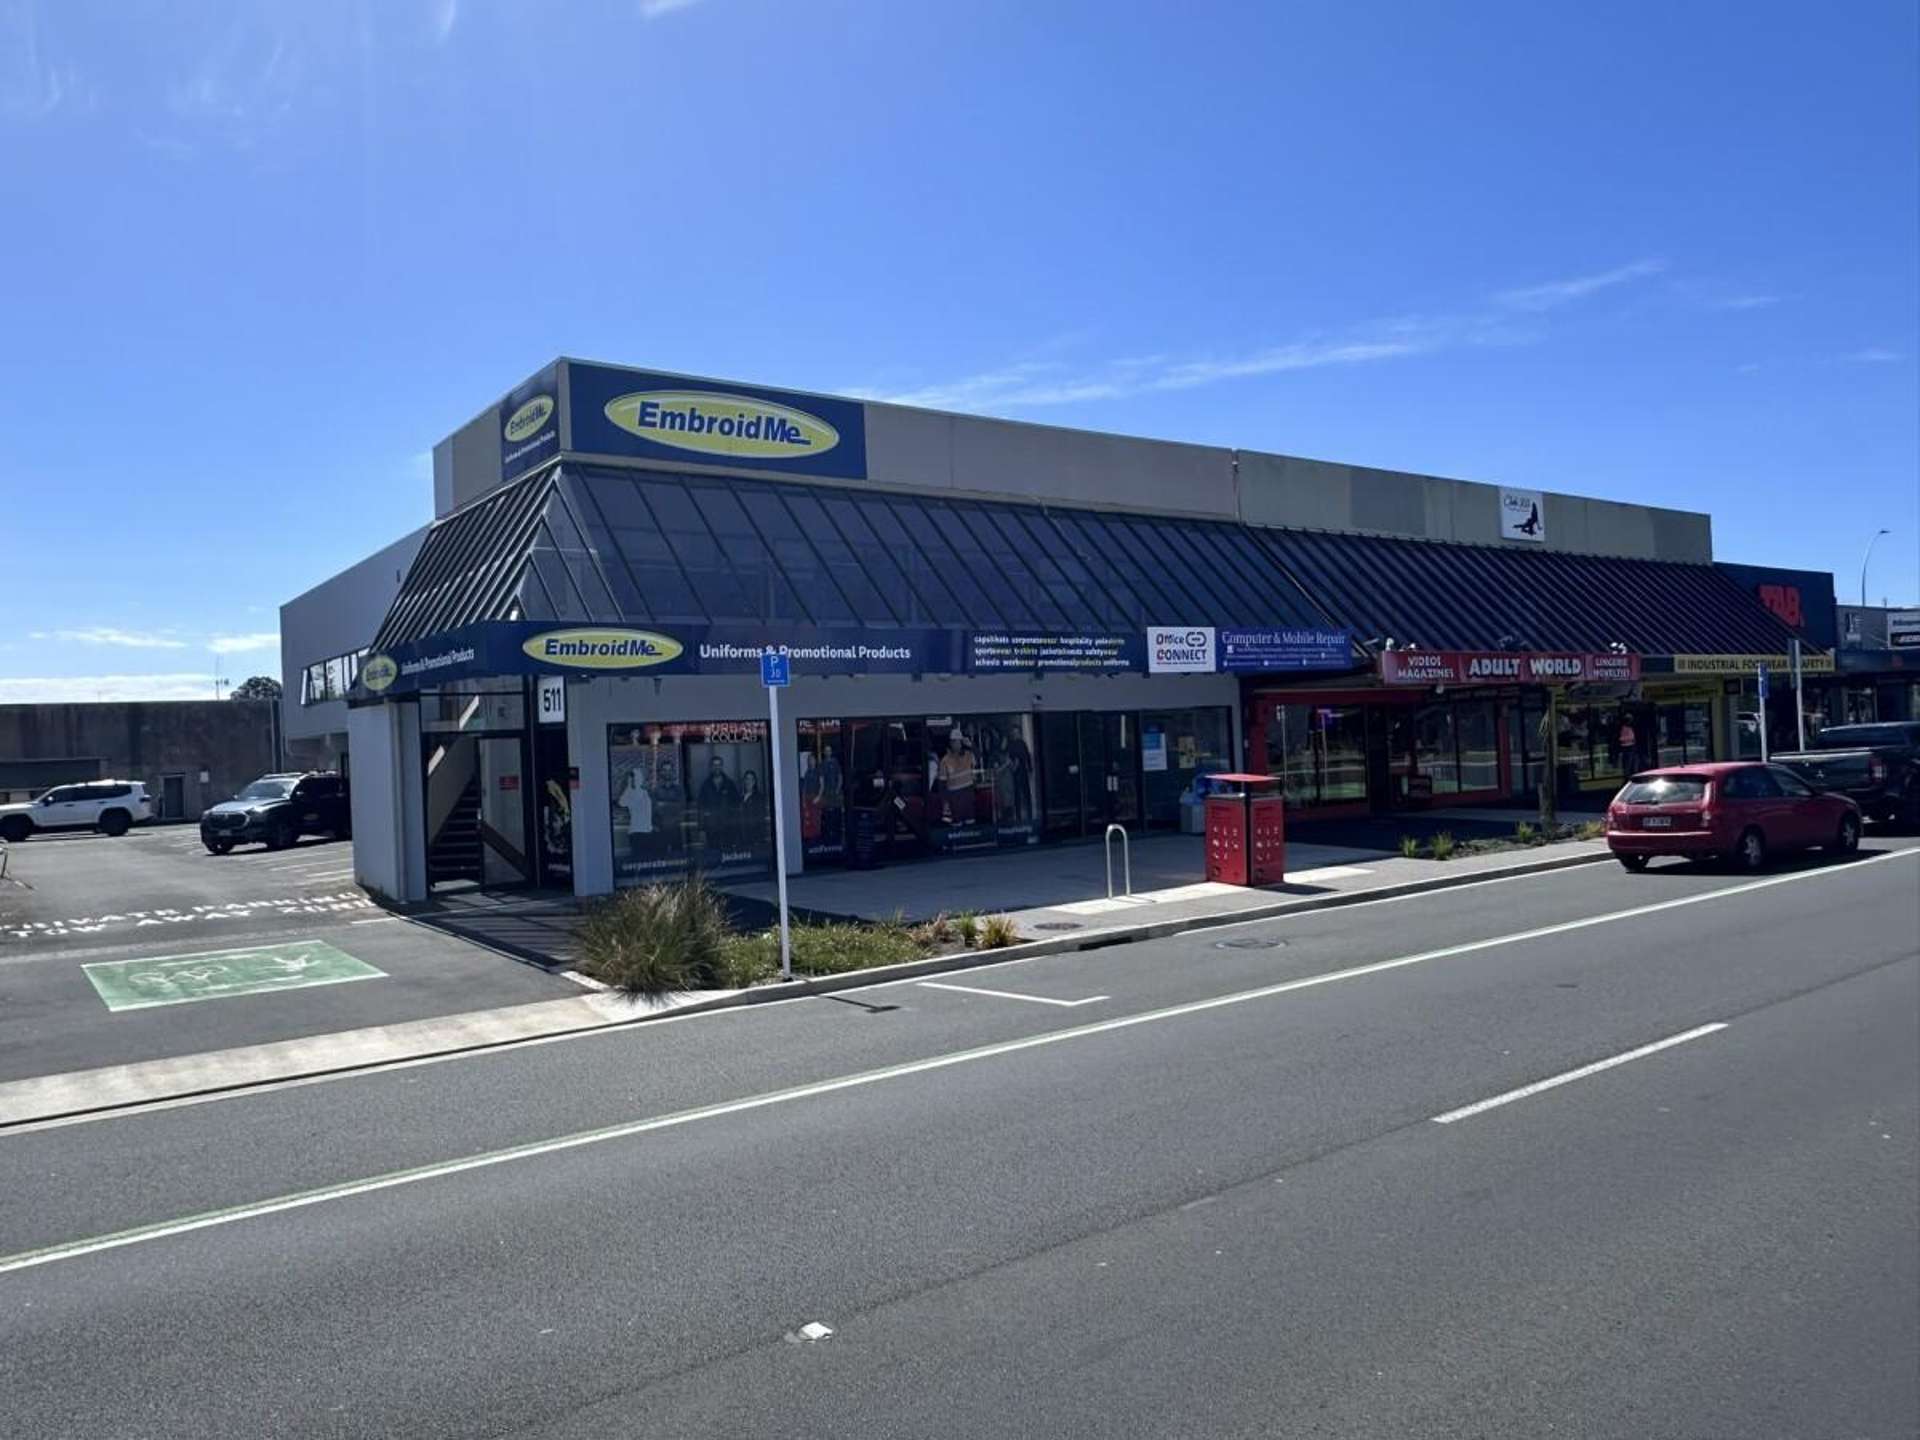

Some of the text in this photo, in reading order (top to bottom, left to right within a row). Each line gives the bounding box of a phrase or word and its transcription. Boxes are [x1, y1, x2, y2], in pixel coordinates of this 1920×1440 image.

[638, 401, 811, 445] EmbroidMe
[1156, 633, 1184, 645] Office
[1221, 631, 1273, 647] Computer
[1282, 632, 1315, 644] Mobile
[1316, 632, 1345, 647] Repair
[545, 638, 663, 656] EmbroidMe
[699, 644, 763, 658] Uniforms
[779, 645, 856, 659] Promotional
[859, 646, 911, 659] Products
[771, 655, 780, 668] P
[1156, 649, 1207, 661] CONNECT
[1469, 658, 1582, 676] ADULT WORLD
[1687, 659, 1739, 670] INDUSTRIAL
[543, 686, 562, 713] 511
